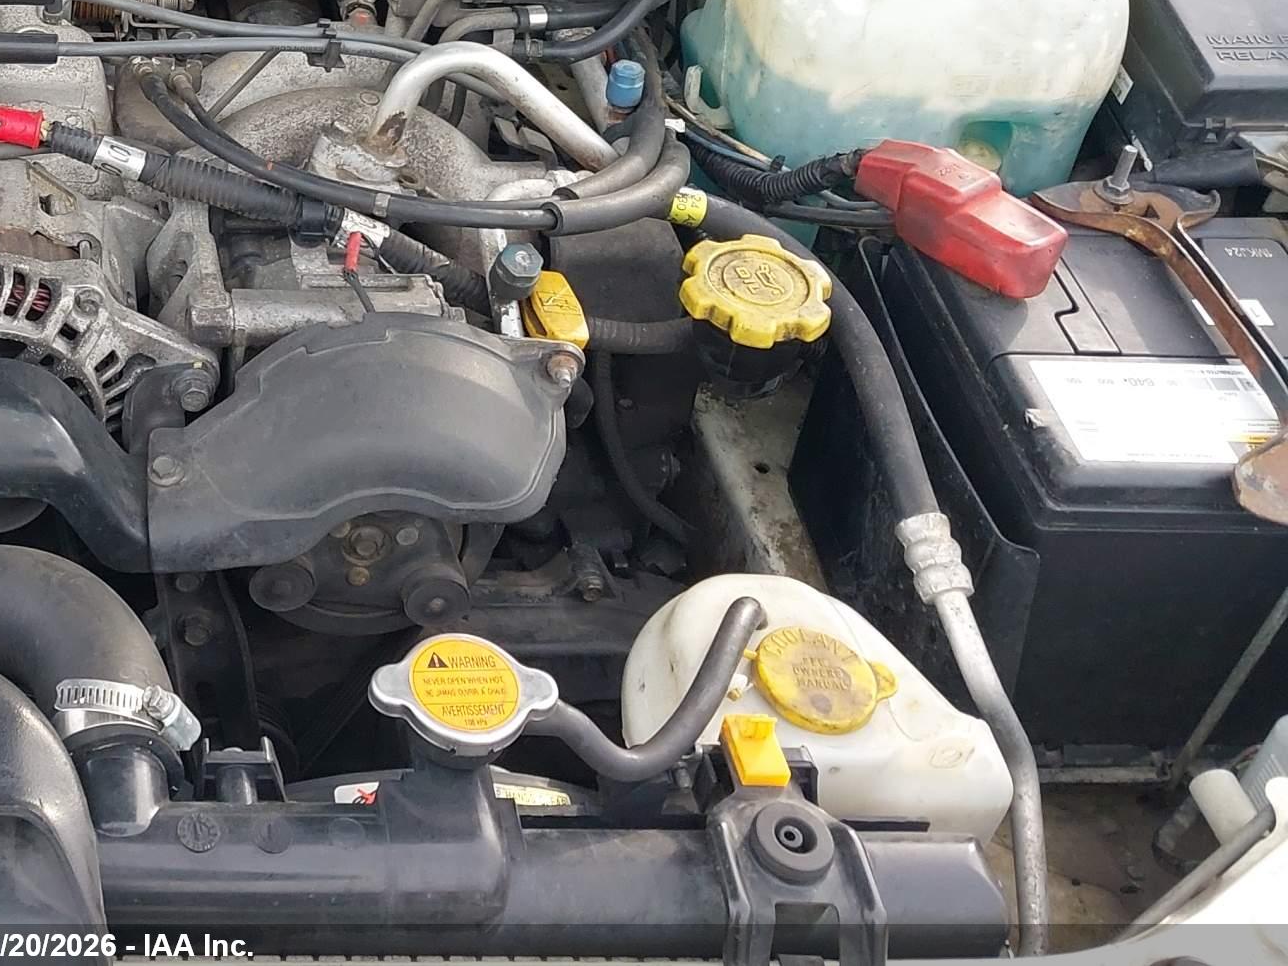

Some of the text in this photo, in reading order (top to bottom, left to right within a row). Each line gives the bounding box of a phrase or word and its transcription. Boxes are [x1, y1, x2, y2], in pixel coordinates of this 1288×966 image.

[1206, 33, 1273, 45] MAIN
[734, 266, 759, 295] OIL
[764, 627, 859, 662] COOLANT
[447, 655, 497, 669] WARNING
[797, 677, 850, 691] MANUAL
[442, 703, 506, 716] AVERTISSEMENT
